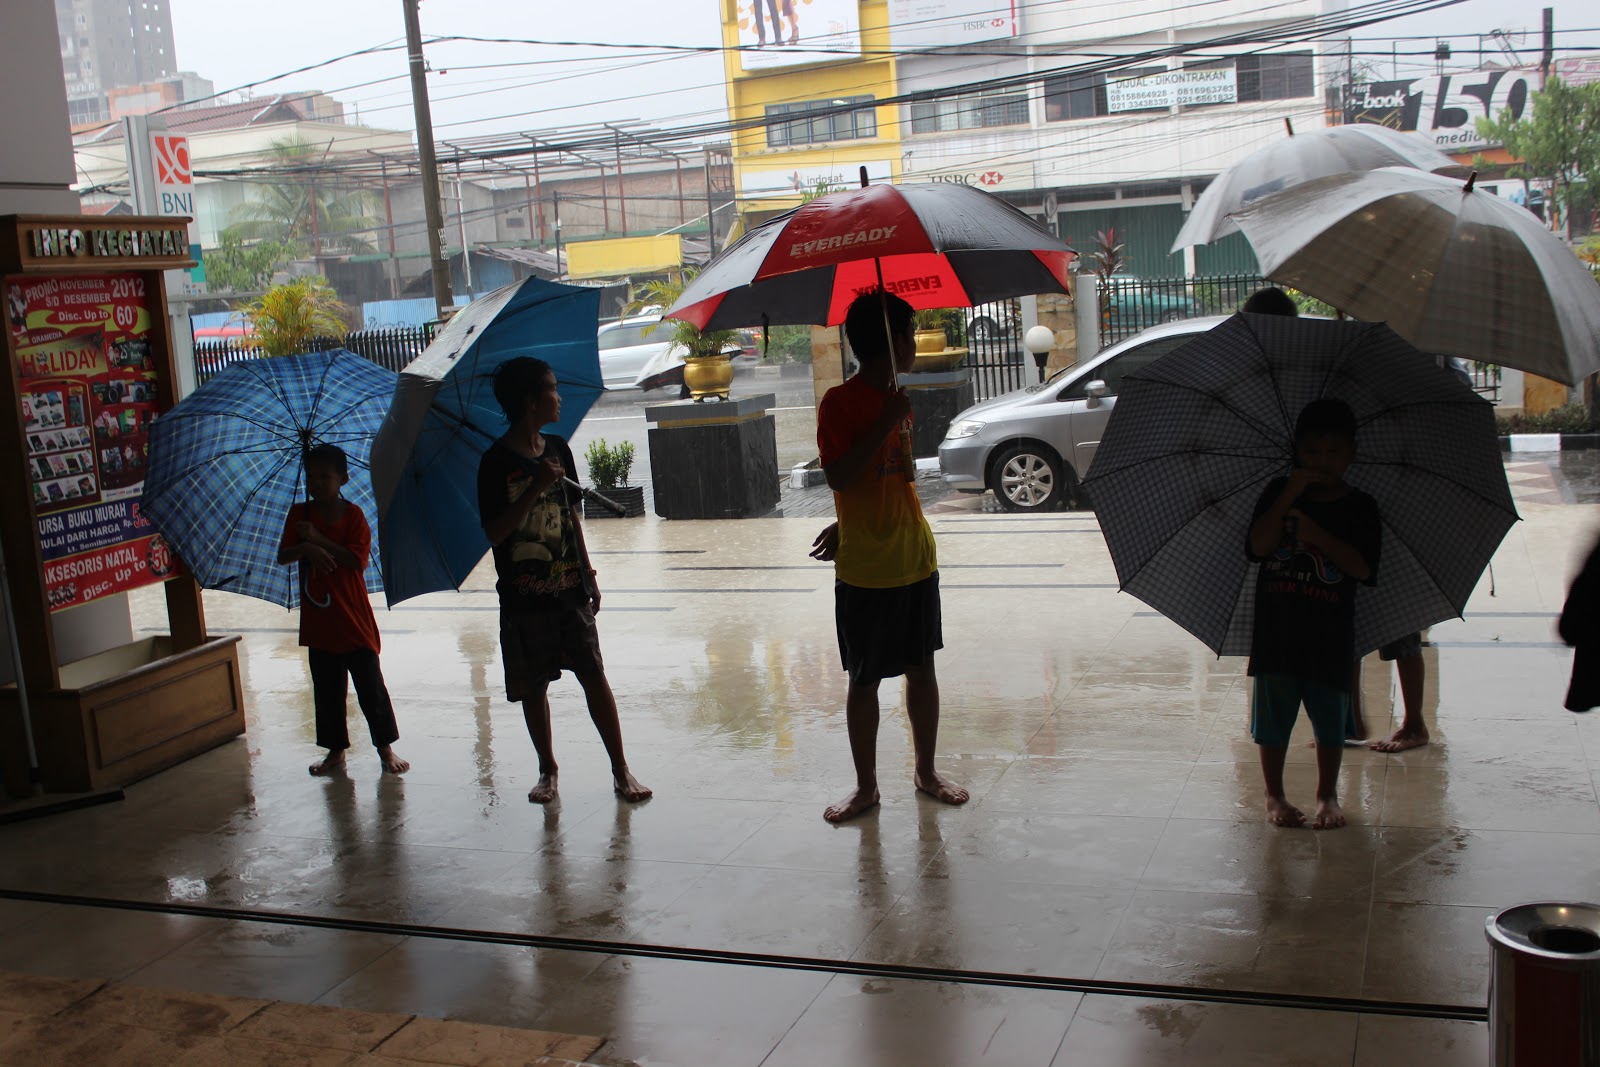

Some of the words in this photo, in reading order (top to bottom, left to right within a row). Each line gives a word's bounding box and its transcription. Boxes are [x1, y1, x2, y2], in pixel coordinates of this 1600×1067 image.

[963, 19, 989, 31] HSBC
[1116, 79, 1149, 89] DIJUAL
[1155, 71, 1227, 86] DIKONTRAKAN
[1111, 102, 1126, 110] 021
[1177, 96, 1193, 104] 021
[1408, 70, 1530, 132] 150
[1435, 131, 1482, 145] media
[807, 173, 844, 186] indosat
[161, 192, 194, 215] BNI
[32, 228, 86, 257] INFO
[91, 229, 189, 256] KEGIATAN
[789, 225, 898, 256] EVEREADY
[25, 278, 59, 304] PROMO
[59, 279, 105, 290] NOVEMBER
[110, 277, 146, 298] 2012
[45, 295, 60, 307] S/D
[64, 292, 112, 305] DESEMBER
[58, 311, 82, 322] Disc.
[83, 310, 97, 321] Up
[99, 310, 109, 319] to
[31, 331, 63, 345] GRAMEDIA
[67, 507, 93, 529] BUKU
[95, 502, 127, 521] MURAH
[66, 530, 88, 544] DARI
[90, 523, 121, 538] HARGA
[105, 546, 139, 569] NATAL
[83, 581, 113, 601] Disc.
[114, 568, 132, 583] Up
[133, 559, 146, 573] to
